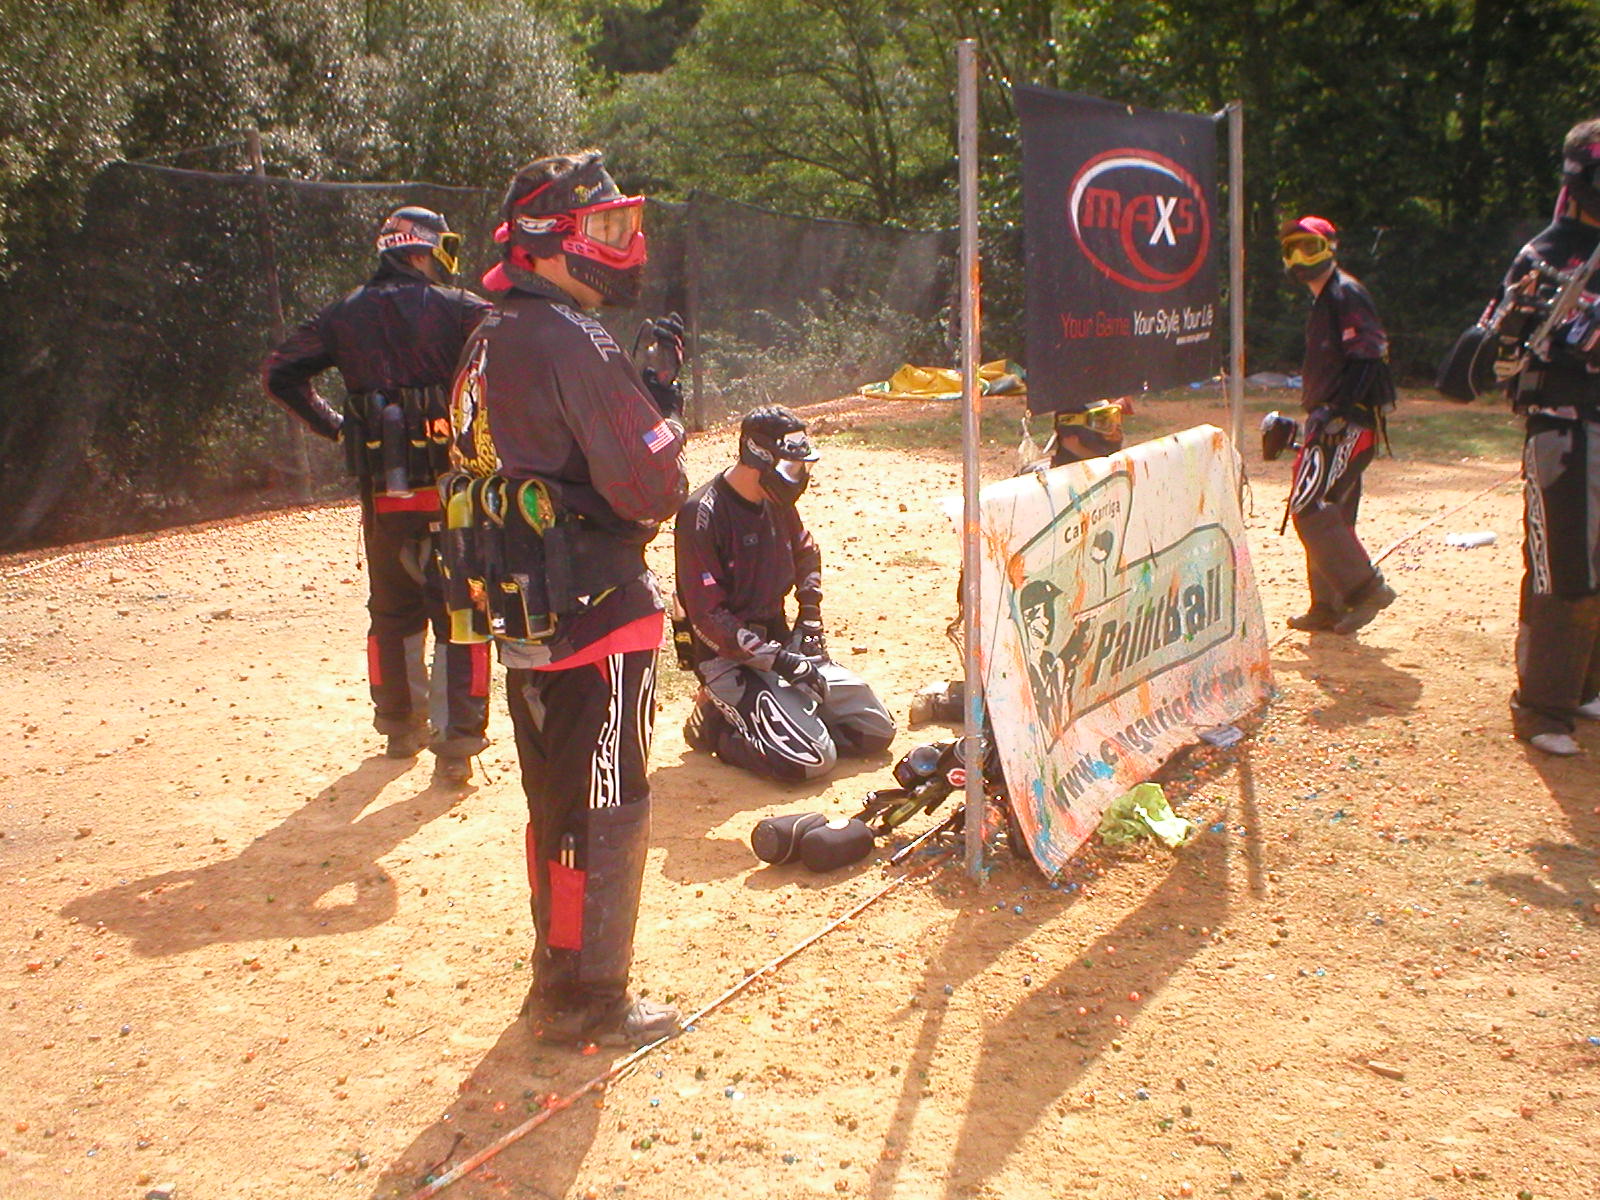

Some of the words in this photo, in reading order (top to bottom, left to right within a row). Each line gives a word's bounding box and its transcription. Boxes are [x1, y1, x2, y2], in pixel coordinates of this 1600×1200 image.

[1060, 311, 1093, 339] Your
[1133, 309, 1155, 336] Your
[1183, 305, 1202, 330] Your
[1064, 519, 1089, 544] Can
[1088, 563, 1222, 688] Paintball
